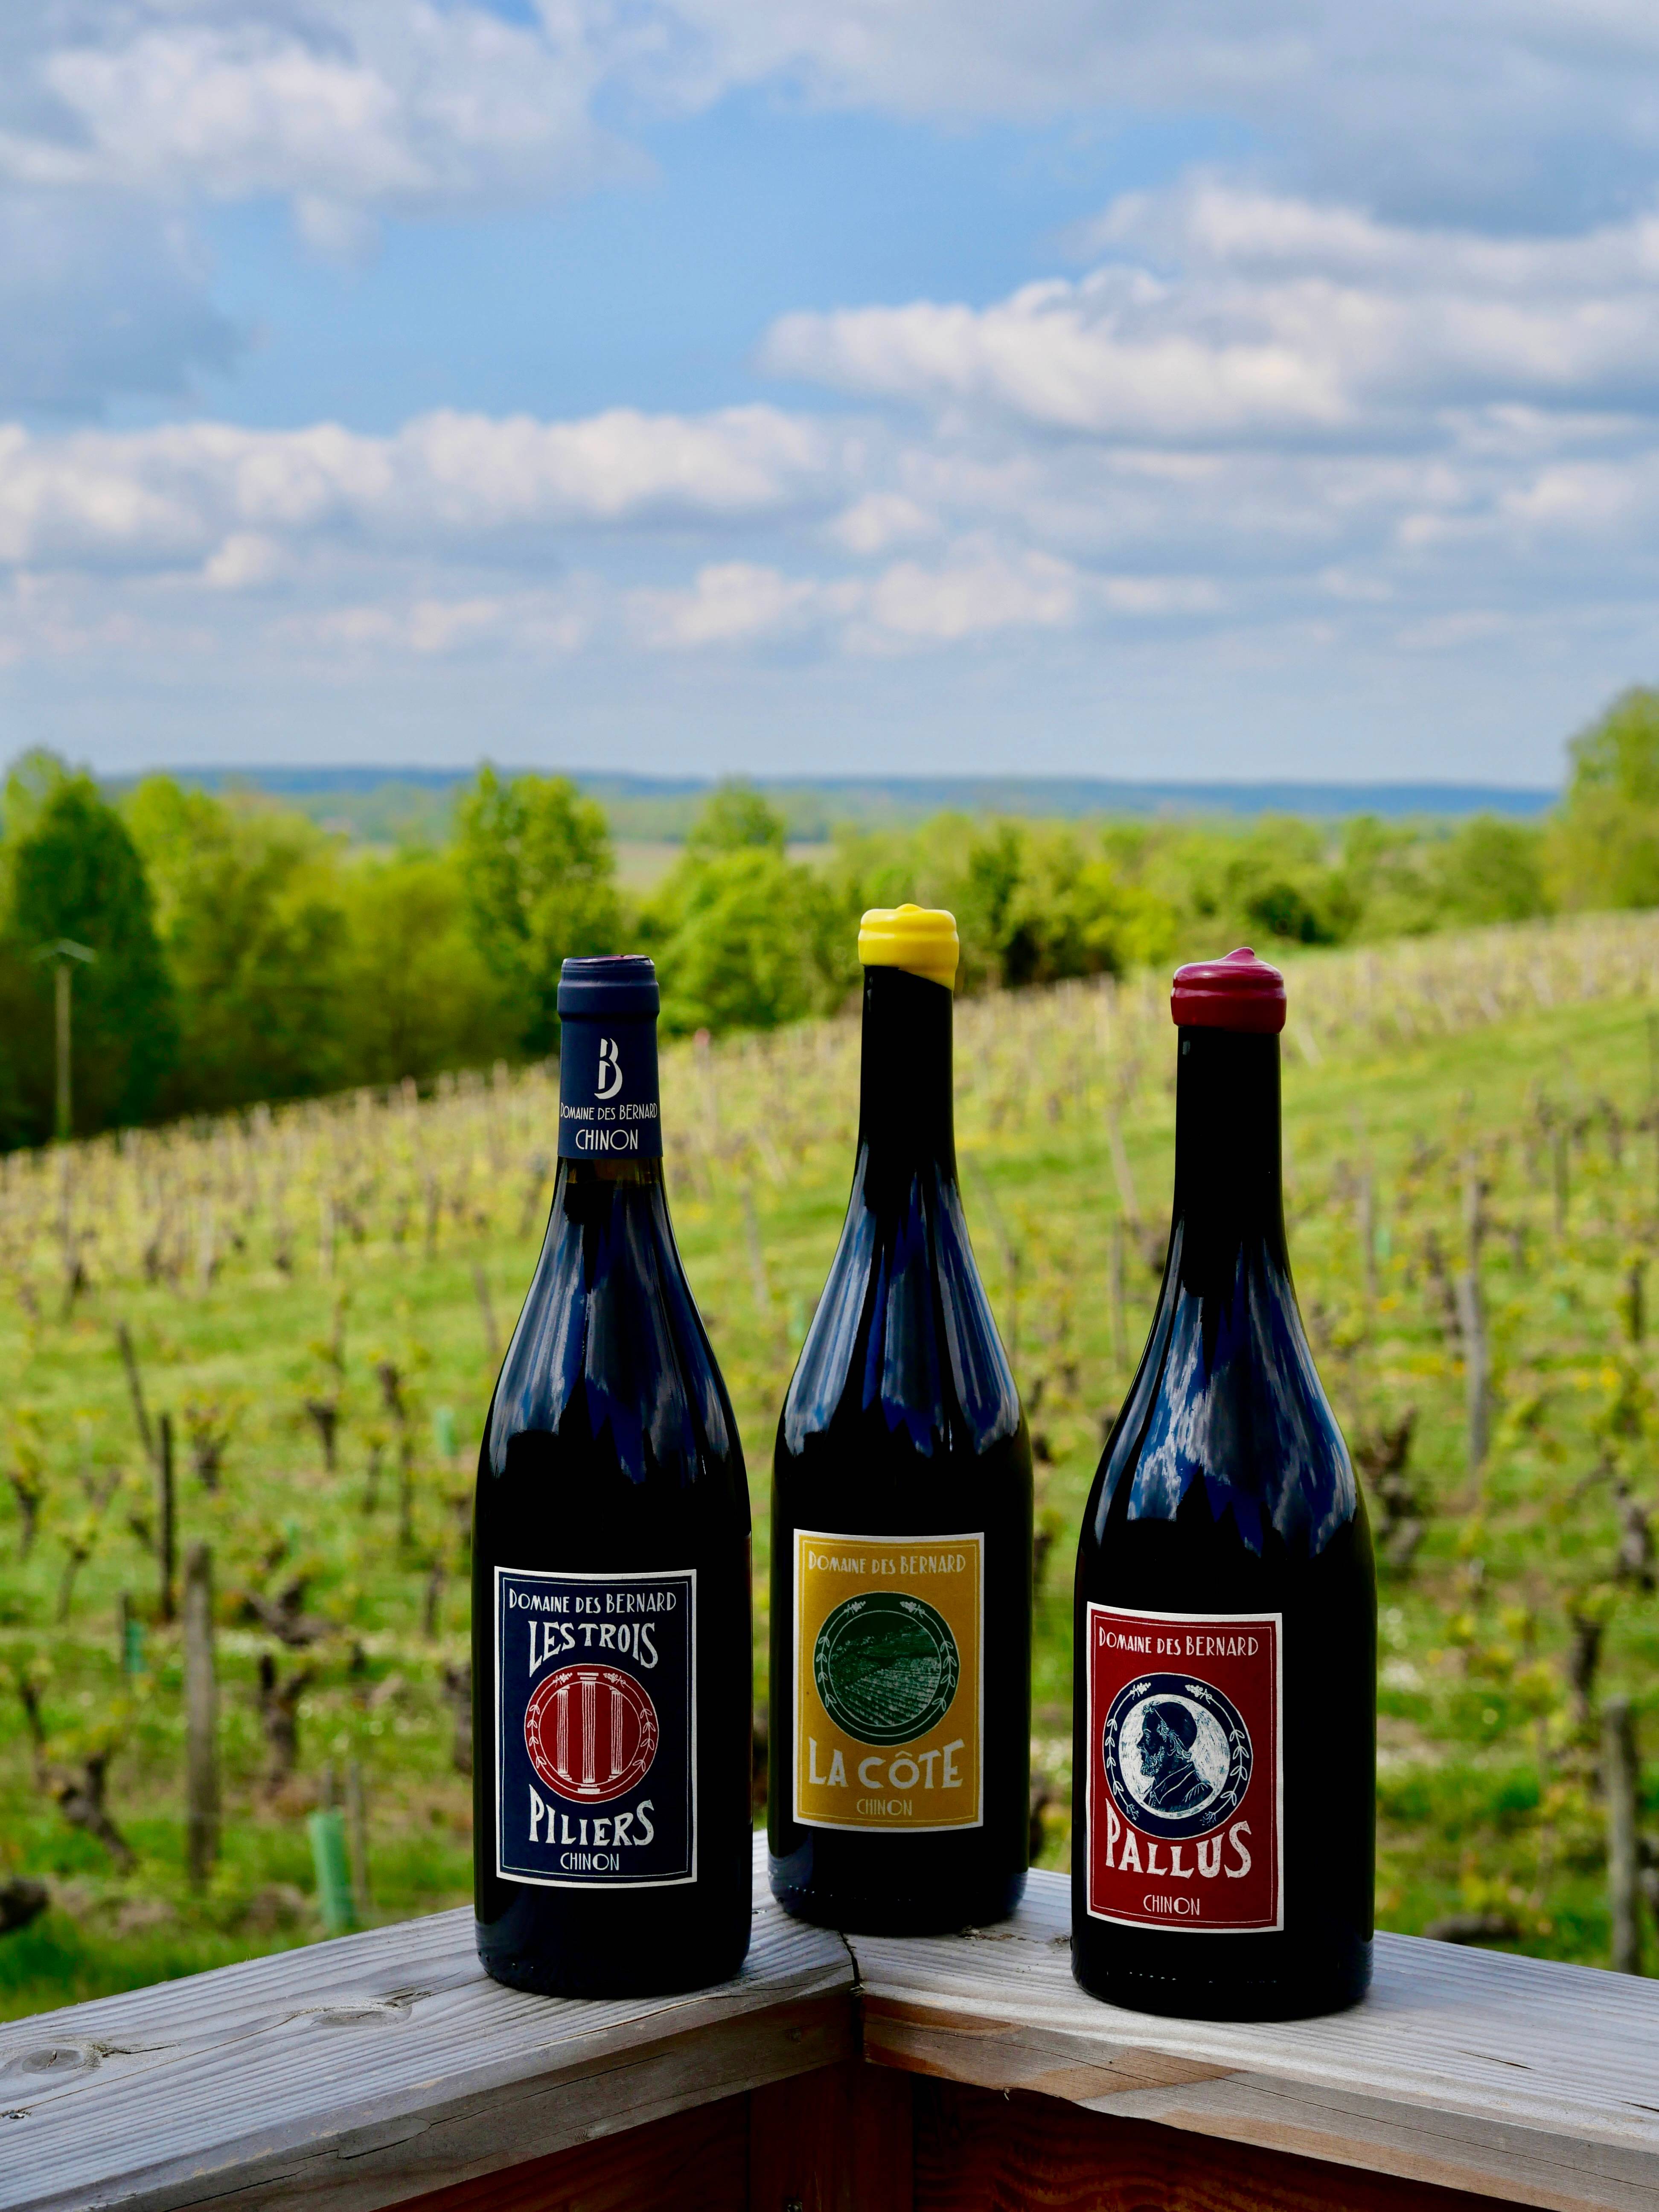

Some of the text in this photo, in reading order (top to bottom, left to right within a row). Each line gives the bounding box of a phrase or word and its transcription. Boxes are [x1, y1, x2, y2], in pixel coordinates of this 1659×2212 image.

[560, 1102, 658, 1121] DOMAINE DES BERNARD
[576, 1129, 638, 1150] CHINON
[809, 1550, 966, 1575] DOMAINE DES BERNARD
[509, 1588, 676, 1613] DOMAINE DES BERNARD
[528, 1621, 658, 1677] LES TROIS
[1099, 1626, 1258, 1656] DOMAINE DES BERNARD
[809, 1736, 965, 1789] LA CÔTE
[529, 1784, 655, 1846] PILIERS
[856, 1799, 912, 1816] CHINON
[1105, 1798, 1252, 1879] PALLUS
[560, 1852, 620, 1871] CHINON
[1143, 1895, 1200, 1915] CHINON
